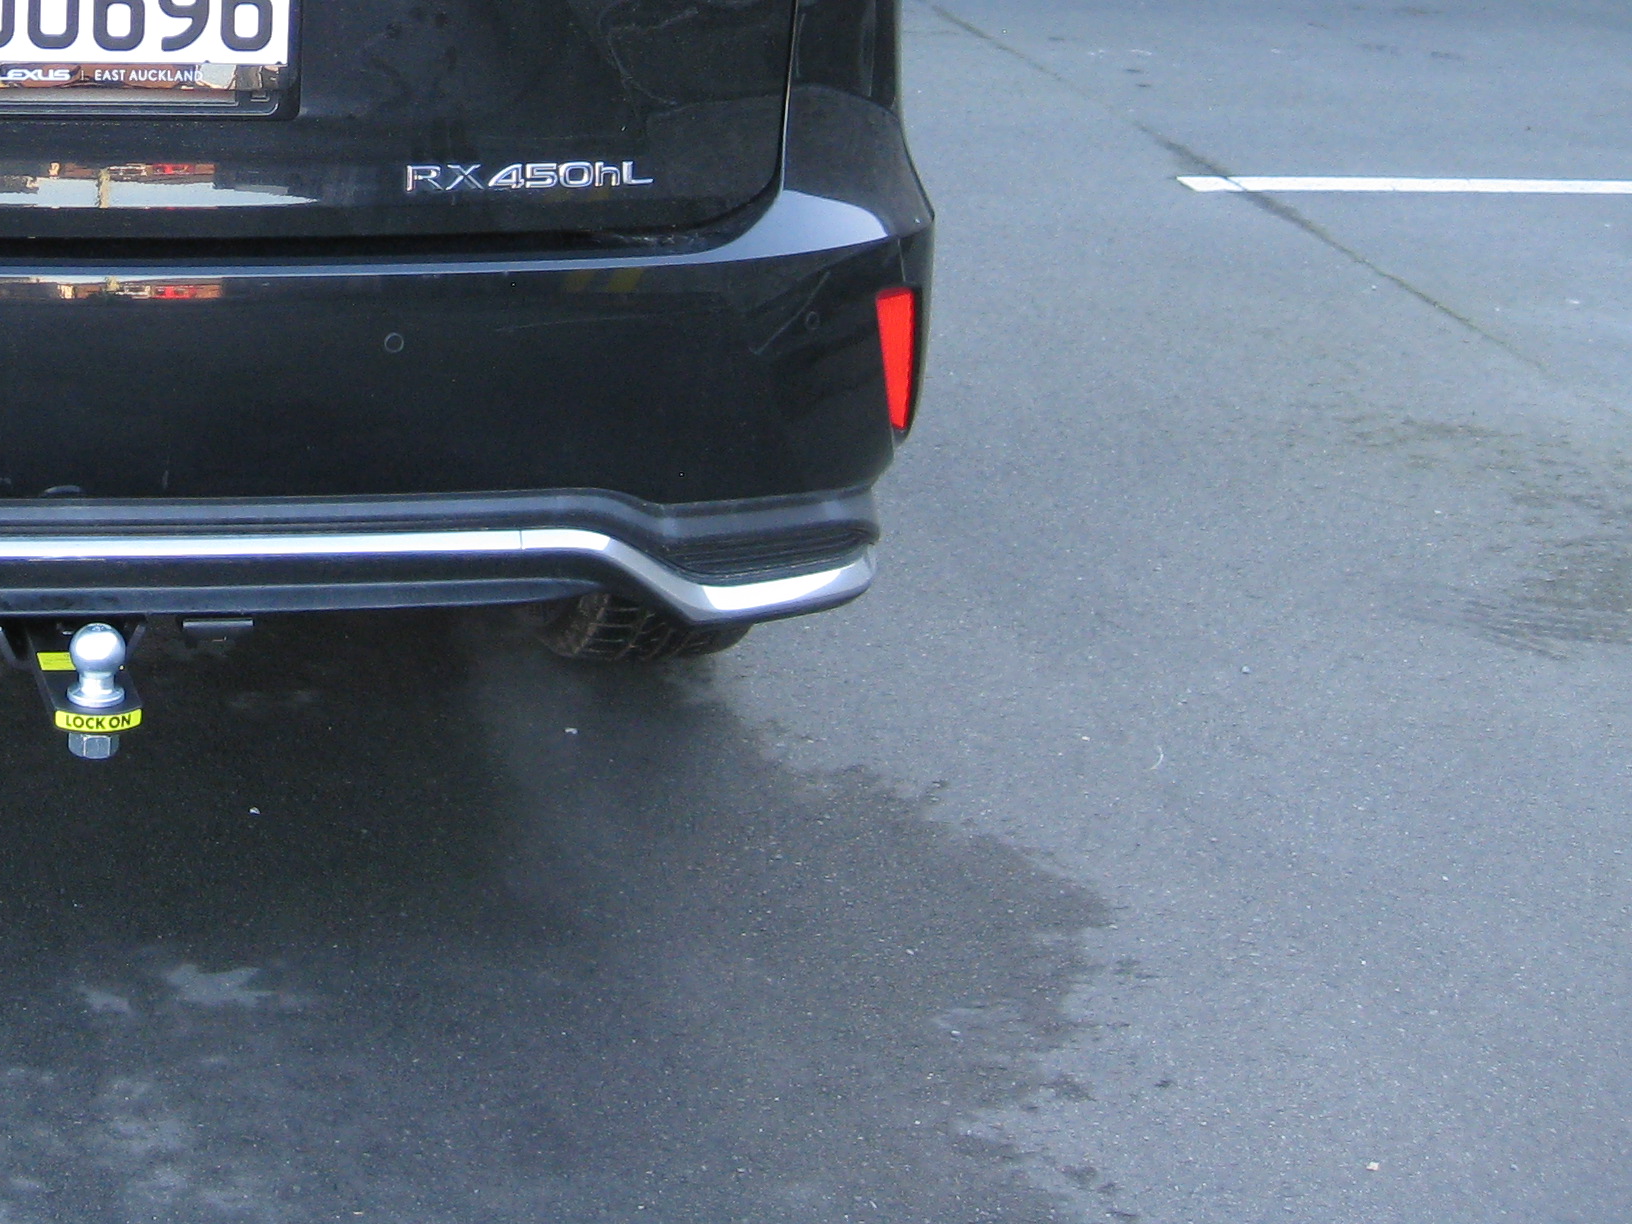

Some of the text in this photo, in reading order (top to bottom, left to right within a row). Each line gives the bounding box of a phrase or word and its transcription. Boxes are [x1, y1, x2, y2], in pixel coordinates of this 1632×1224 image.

[94, 68, 126, 83] EAST
[128, 68, 204, 84] AUCKLAND
[65, 713, 131, 729] LOCK ON
